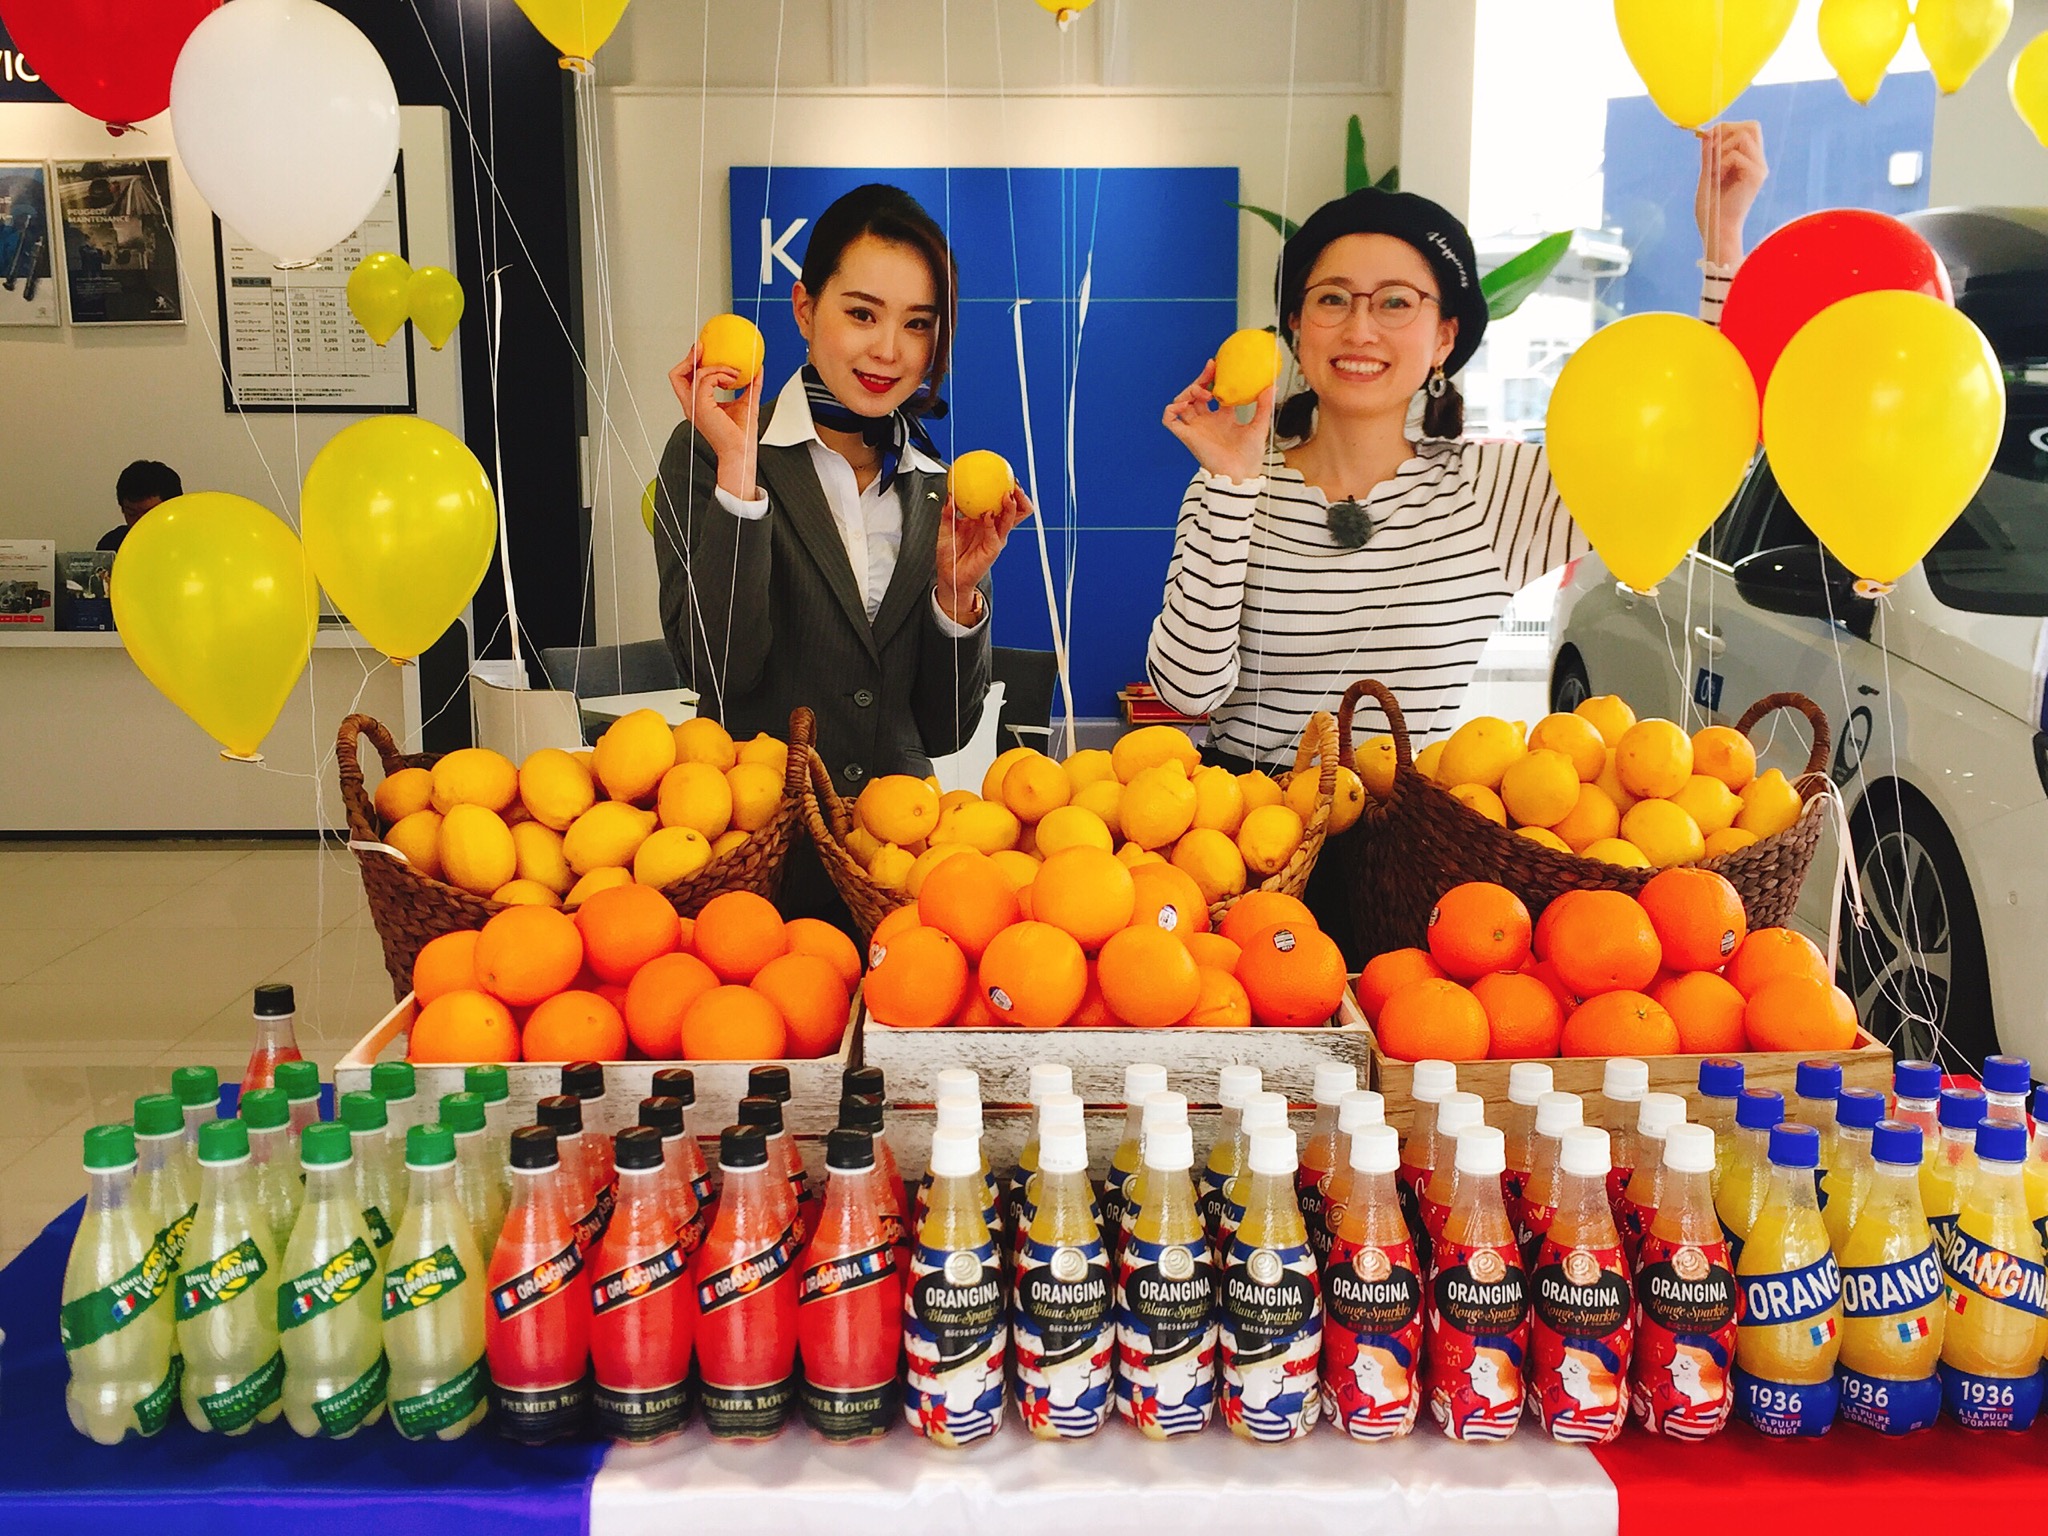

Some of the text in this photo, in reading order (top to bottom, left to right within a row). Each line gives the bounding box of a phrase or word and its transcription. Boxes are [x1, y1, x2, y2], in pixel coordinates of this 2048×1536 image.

[0, 50, 40, 82] IC
[68, 215, 130, 223] MAINTENANCE
[110, 1275, 143, 1297] HONEY
[185, 1273, 210, 1288] HONEY
[293, 1277, 322, 1294] HONEY
[516, 1254, 577, 1300] ORANGINA
[606, 1260, 670, 1300] ORANGINA
[715, 1255, 778, 1298] ORANGINA
[806, 1261, 863, 1294] ORANGINA
[1750, 1254, 1841, 1320] ORANG
[1843, 1249, 1943, 1312] ORANGI
[925, 1282, 1000, 1308] ORANGINA
[1032, 1279, 1106, 1305] ORANGINA
[1139, 1277, 1211, 1302] ORANGINA
[1229, 1278, 1302, 1306] ORANGINA
[1333, 1277, 1410, 1303] ORANGINA
[1447, 1281, 1523, 1305] ORANGINA
[1542, 1279, 1620, 1307] ORANGINA
[1651, 1277, 1728, 1303] ORANGINA
[926, 1308, 962, 1323] Blanc
[1032, 1303, 1066, 1318] Blanc
[1138, 1301, 1174, 1317] Blanc
[1229, 1301, 1303, 1325] Blanc Sparkle
[1334, 1300, 1410, 1322] Rouge Sparkle
[1447, 1302, 1485, 1324] Rouge
[1544, 1302, 1620, 1326] Rouge Sparkle
[1652, 1299, 1729, 1323] Rouge Sparkle
[1750, 1385, 1802, 1413] 1936
[1842, 1376, 1889, 1408] 1936
[1961, 1381, 2015, 1406] 1936
[501, 1398, 557, 1413] PREMIER
[834, 1397, 882, 1414] ROUGE
[1847, 1404, 1857, 1413] LA
[1860, 1408, 1891, 1425] PULPE
[1967, 1411, 1980, 1419] LA
[1983, 1413, 2014, 1421] PULPE
[1756, 1415, 1766, 1424] LA
[1770, 1418, 1802, 1428] PULPE
